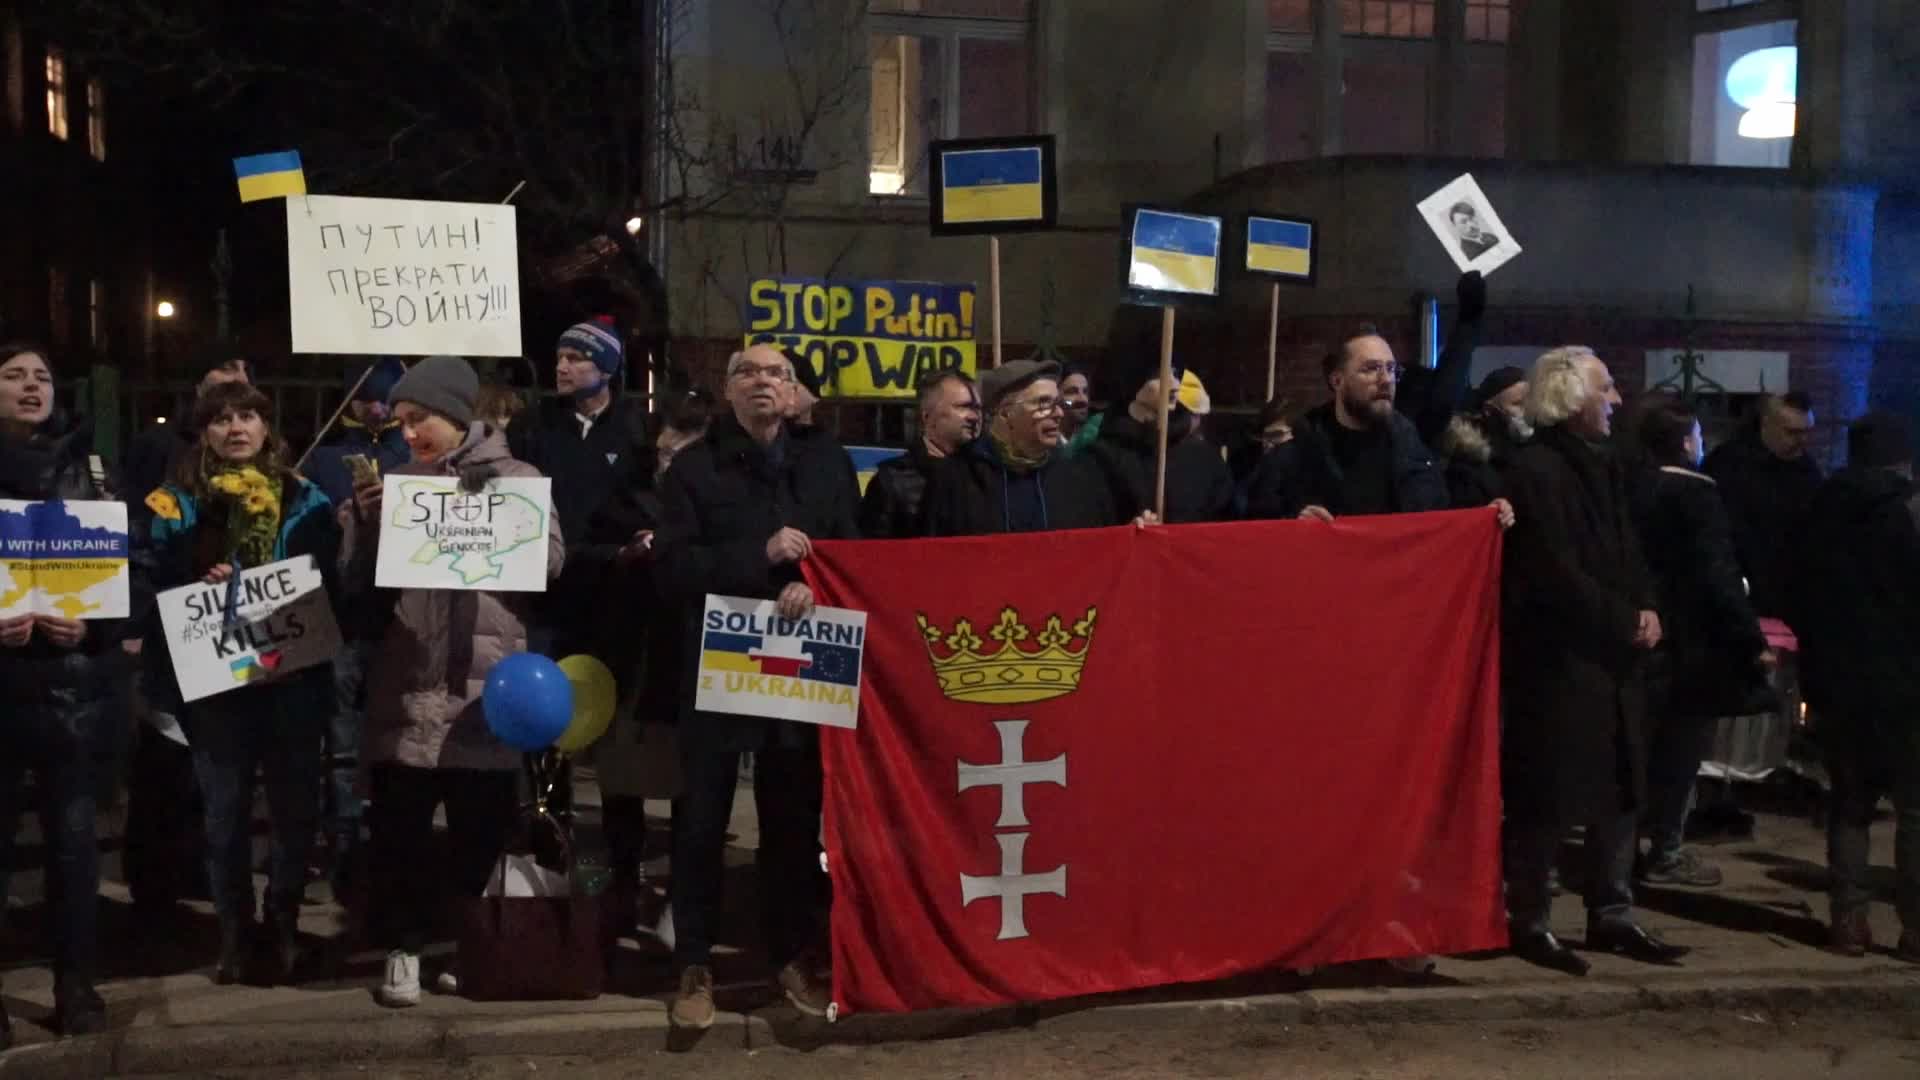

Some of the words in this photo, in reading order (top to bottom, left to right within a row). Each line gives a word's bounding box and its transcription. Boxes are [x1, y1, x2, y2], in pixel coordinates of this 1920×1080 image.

[320, 216, 480, 253] ПУТИН!
[327, 263, 488, 304] ПРЕКРАТИ
[368, 284, 508, 328] ВОЙНУ!!!
[750, 279, 853, 331] STOP
[865, 286, 974, 338] Putin!
[752, 333, 859, 389] OP
[411, 491, 506, 523] STOP
[8, 540, 46, 551] WITH
[51, 540, 120, 551] UKRAINE
[185, 568, 296, 621] SILNCE
[212, 612, 305, 659] KILLS
[706, 610, 863, 645] SOLIDARNI
